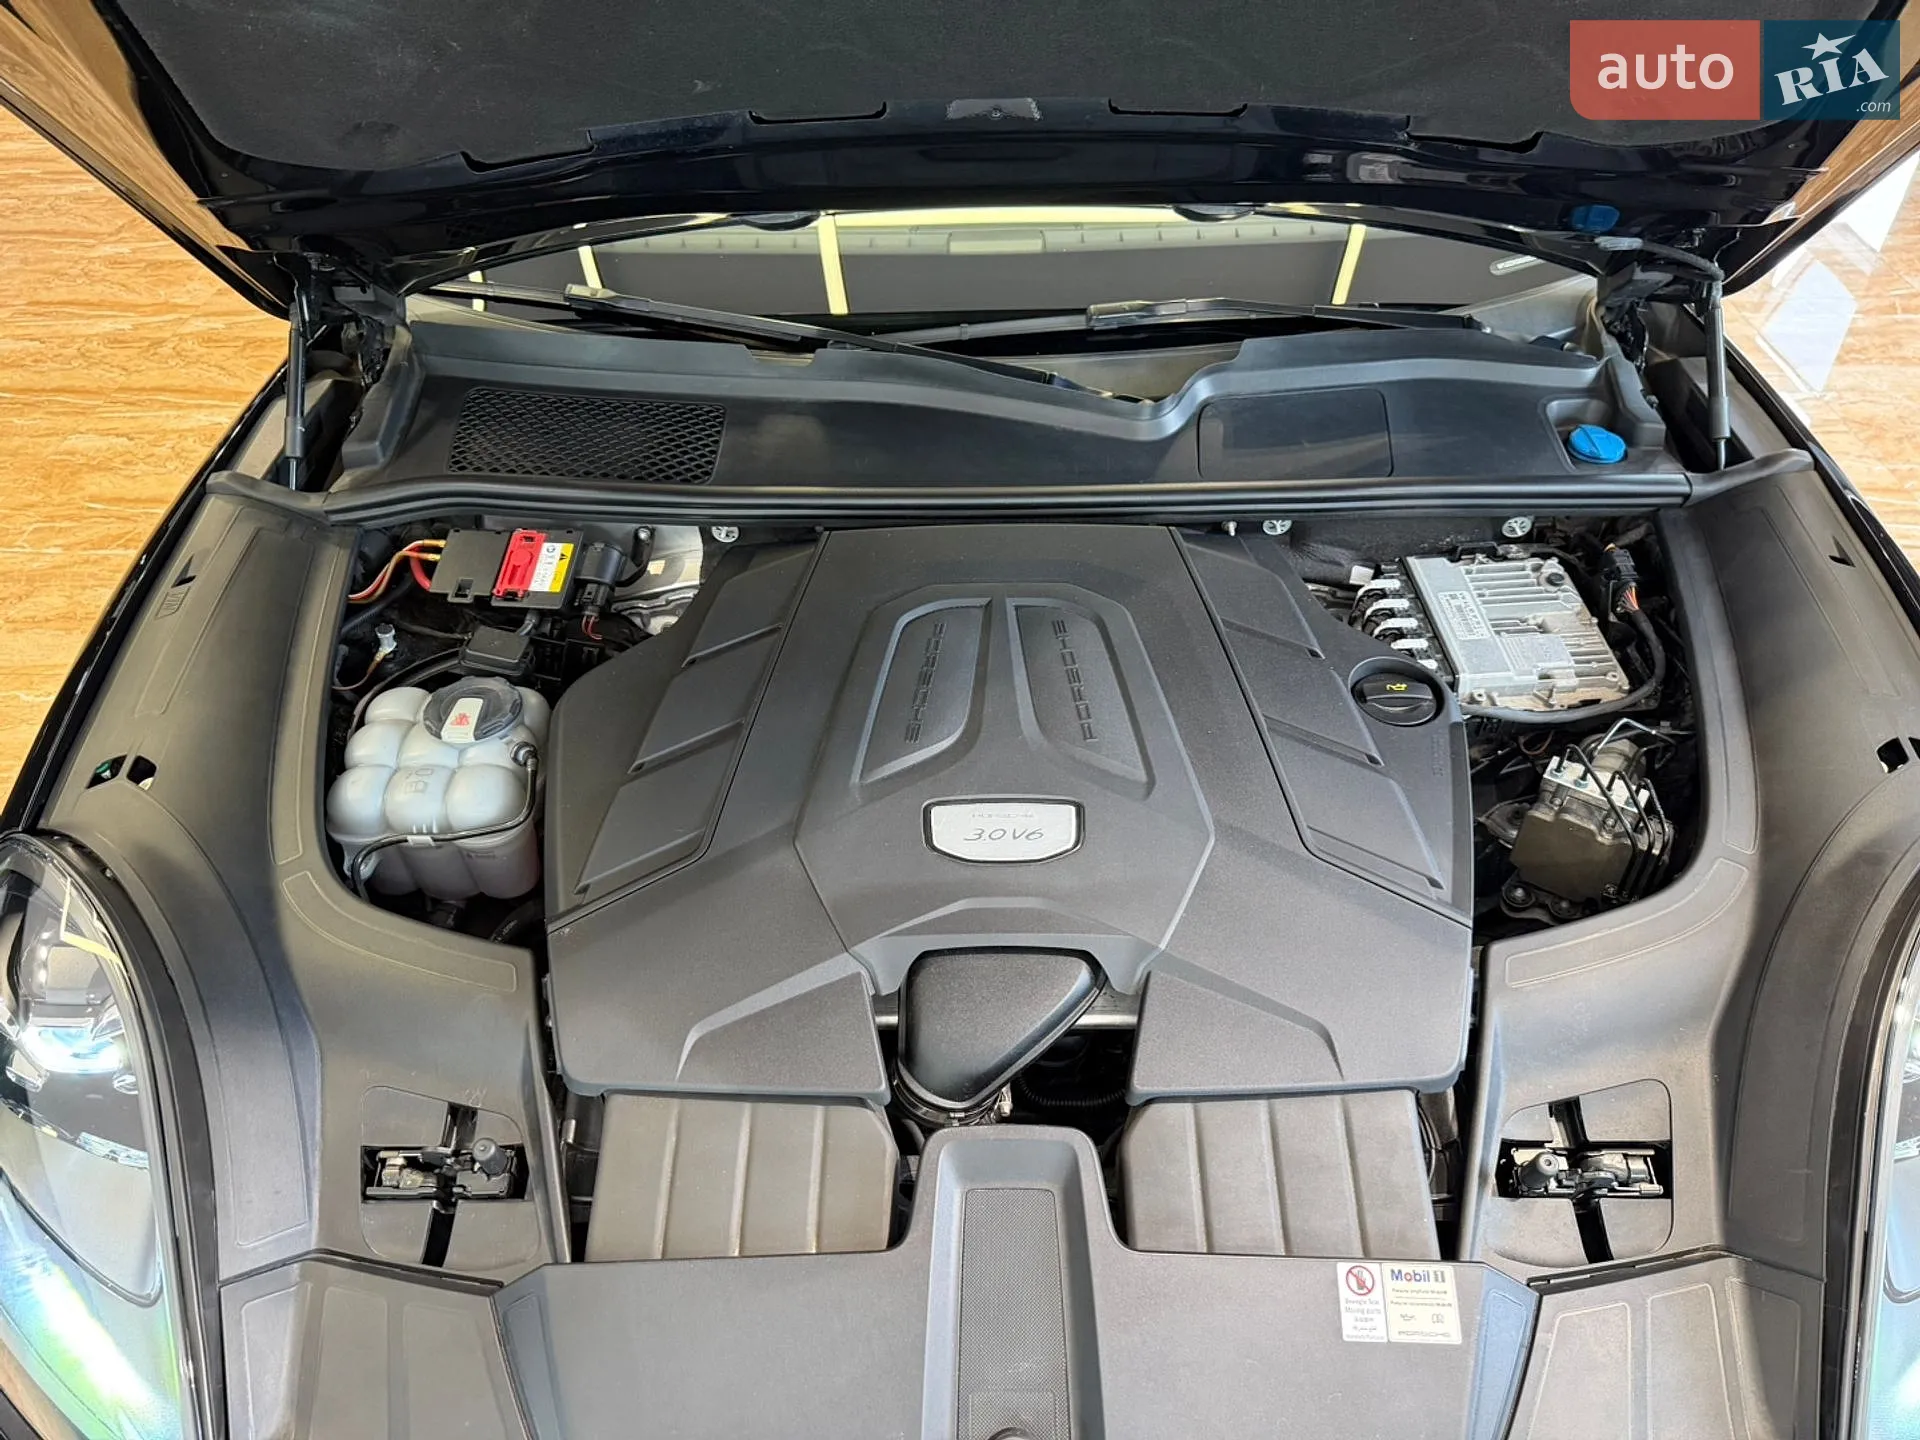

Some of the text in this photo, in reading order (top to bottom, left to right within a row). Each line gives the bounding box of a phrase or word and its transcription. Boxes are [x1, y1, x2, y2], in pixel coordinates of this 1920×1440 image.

[905, 623, 947, 743] PORSCHE
[1051, 619, 1098, 742] PORSCHE
[1390, 1268, 1431, 1283] Mobil
